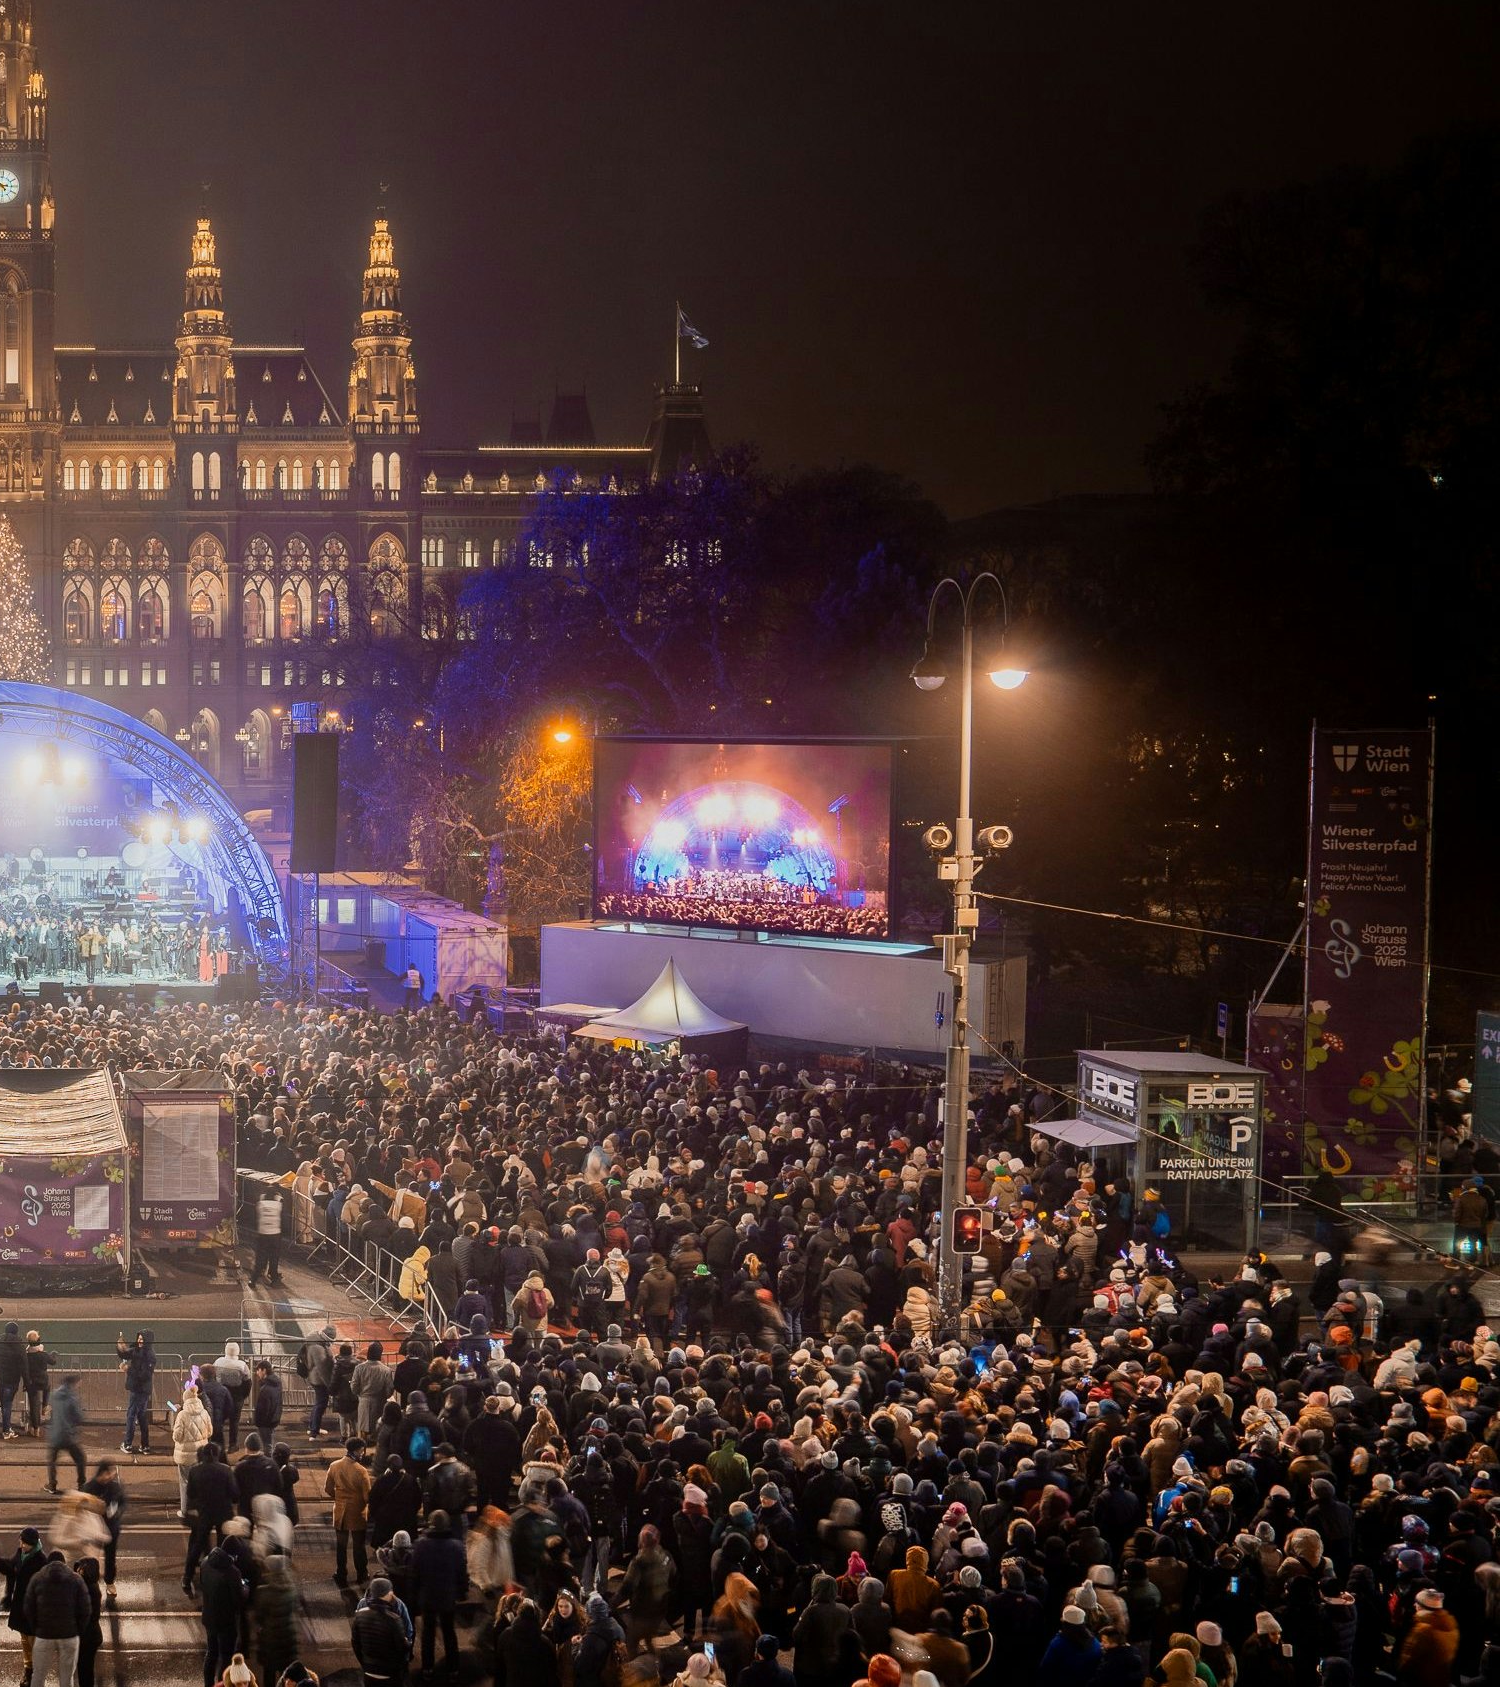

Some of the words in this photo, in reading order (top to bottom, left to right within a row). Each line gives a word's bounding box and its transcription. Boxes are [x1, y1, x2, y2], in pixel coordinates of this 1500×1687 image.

[1366, 745, 1411, 758] Stadt
[1365, 760, 1410, 772] Wien
[54, 816, 121, 829] Silvesterpf
[1322, 825, 1375, 836] Wiener
[1322, 839, 1417, 853] Silvesterpfad
[1321, 862, 1346, 871] Prosit
[1348, 864, 1387, 873] Neujahr!
[1320, 874, 1351, 882] Happy
[1320, 882, 1345, 891] Felice
[1346, 883, 1372, 891] Anno
[1373, 884, 1406, 892] Nuovo!
[1361, 924, 1408, 934] Johann
[1361, 934, 1407, 944] Strauss
[1374, 945, 1406, 956] 2025
[1374, 956, 1406, 967] Wien
[1482, 1028, 1500, 1042] EXI
[1092, 1070, 1134, 1107] BOE
[1187, 1082, 1255, 1105] BOE
[1231, 1125, 1252, 1152] P
[1160, 1159, 1205, 1168] PARKEN
[1208, 1158, 1254, 1168] UNTERM
[1167, 1170, 1254, 1180] RATHAUSPLATZ
